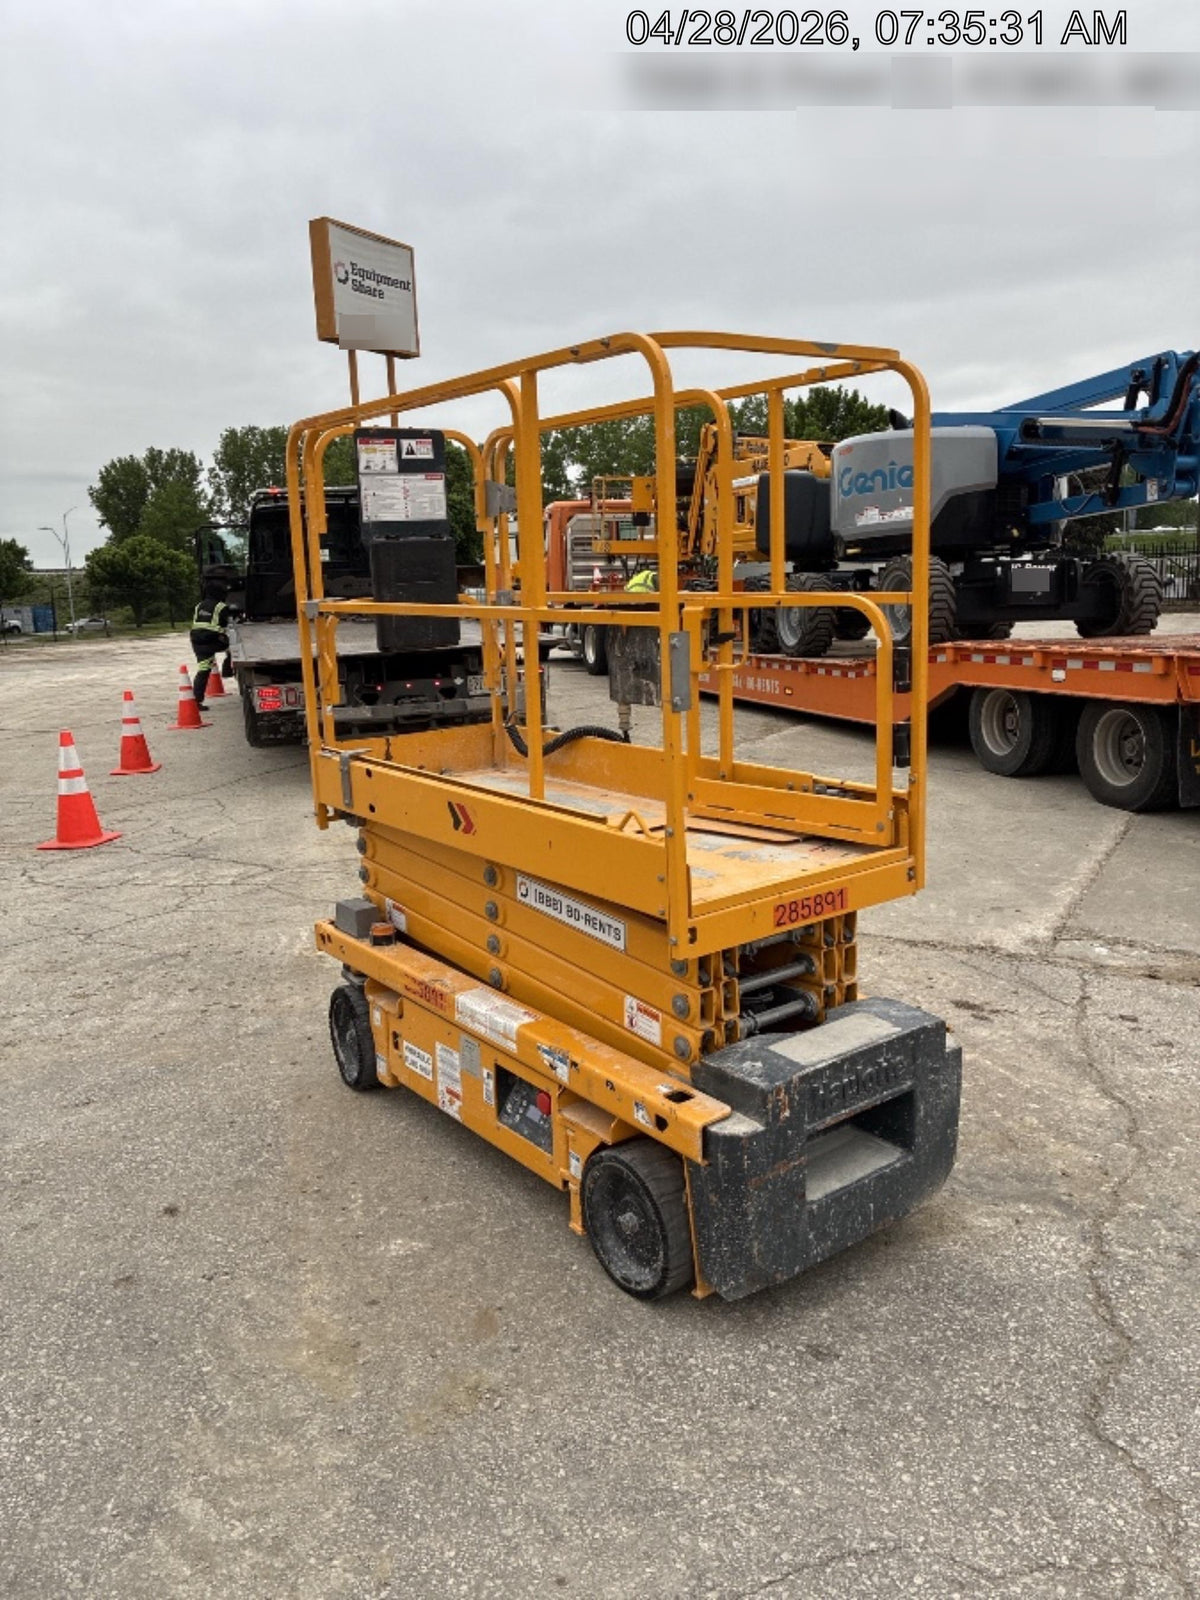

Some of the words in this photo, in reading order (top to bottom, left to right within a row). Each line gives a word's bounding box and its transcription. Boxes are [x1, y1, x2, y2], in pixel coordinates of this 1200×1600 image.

[350, 261, 411, 292] Equipment
[351, 278, 385, 300] Share
[839, 460, 914, 497] Genie
[534, 888, 562, 914] (888)
[566, 904, 621, 941] 80-RENTS
[775, 888, 844, 927] 285891
